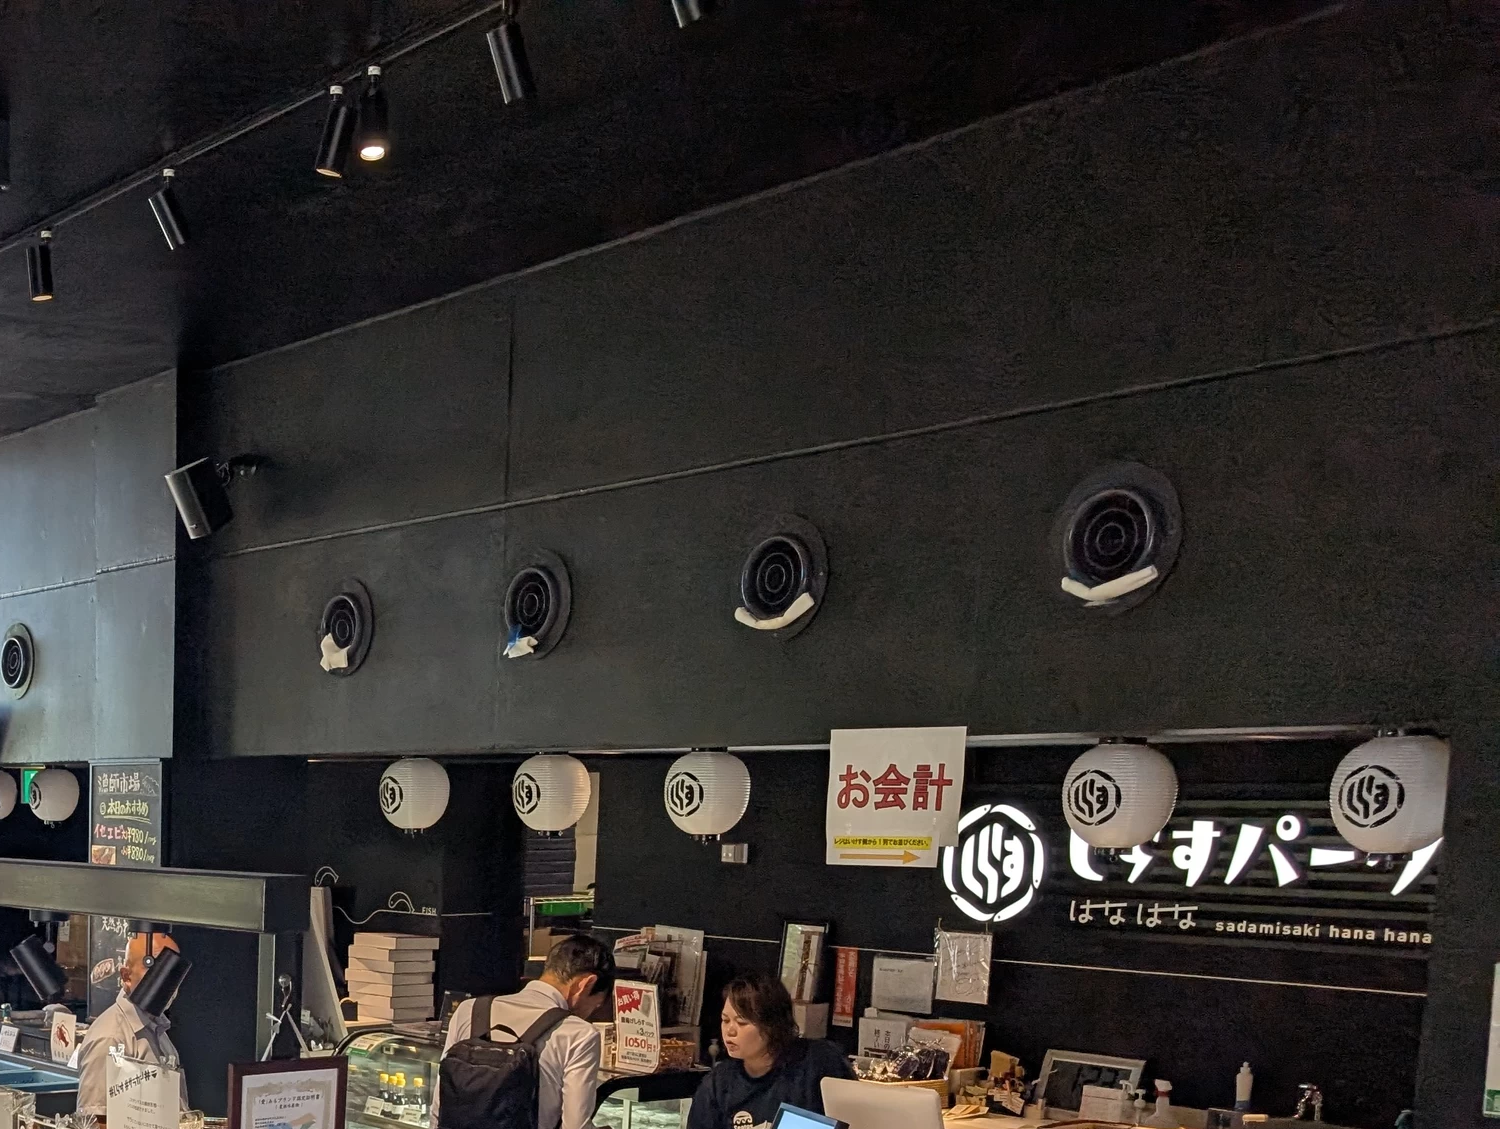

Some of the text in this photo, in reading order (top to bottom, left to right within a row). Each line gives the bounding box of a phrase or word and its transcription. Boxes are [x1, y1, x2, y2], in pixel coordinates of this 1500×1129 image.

[97, 772, 140, 793] 漁師市場
[837, 763, 953, 811] お会計
[422, 906, 437, 915] FISH
[1215, 919, 1433, 944] sadamisaki hana hana
